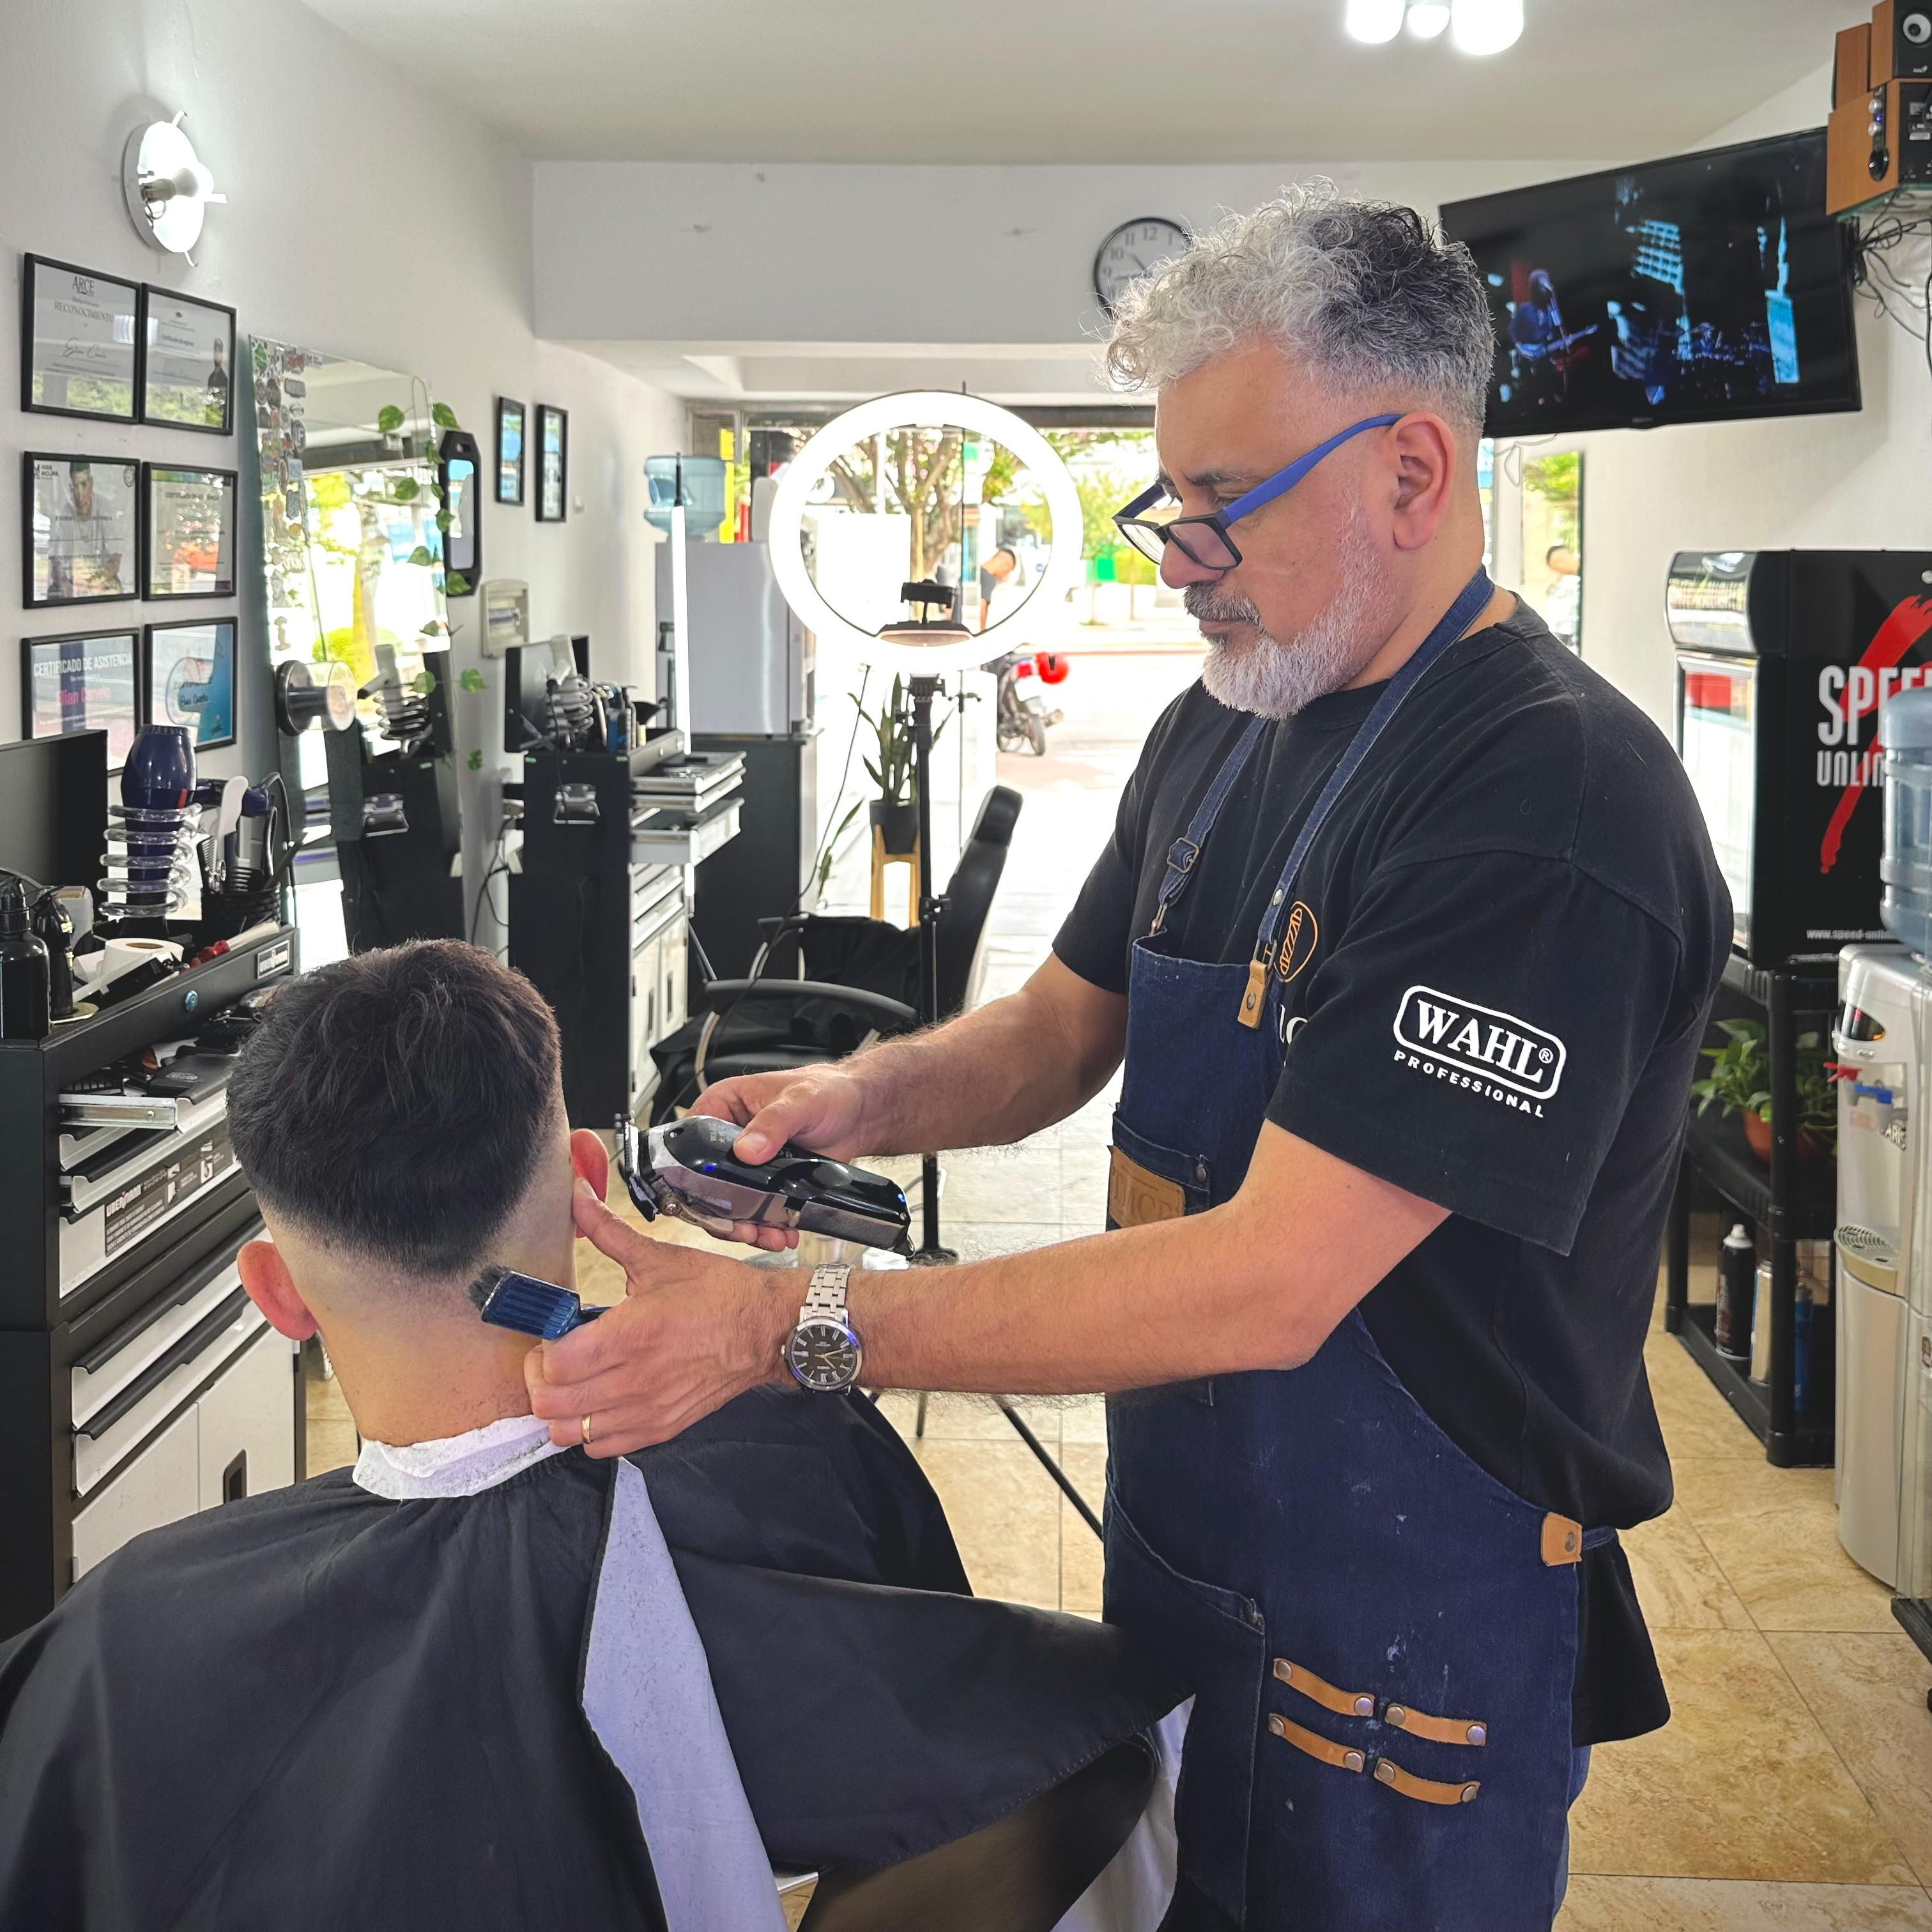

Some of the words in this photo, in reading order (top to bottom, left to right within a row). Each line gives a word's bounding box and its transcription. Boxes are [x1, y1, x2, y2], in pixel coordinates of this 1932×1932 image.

[1125, 233, 1135, 246] 11
[1143, 226, 1158, 241] 12
[1168, 233, 1172, 246] 1
[1110, 247, 1124, 261] 10
[1102, 266, 1112, 277] 9
[72, 275, 95, 295] ARCE
[34, 658, 82, 677] CERTIFICADO
[83, 657, 93, 671] DE
[94, 653, 132, 669] ASISTENCIA
[1393, 1050, 1544, 1118] PROFESSIONAL
